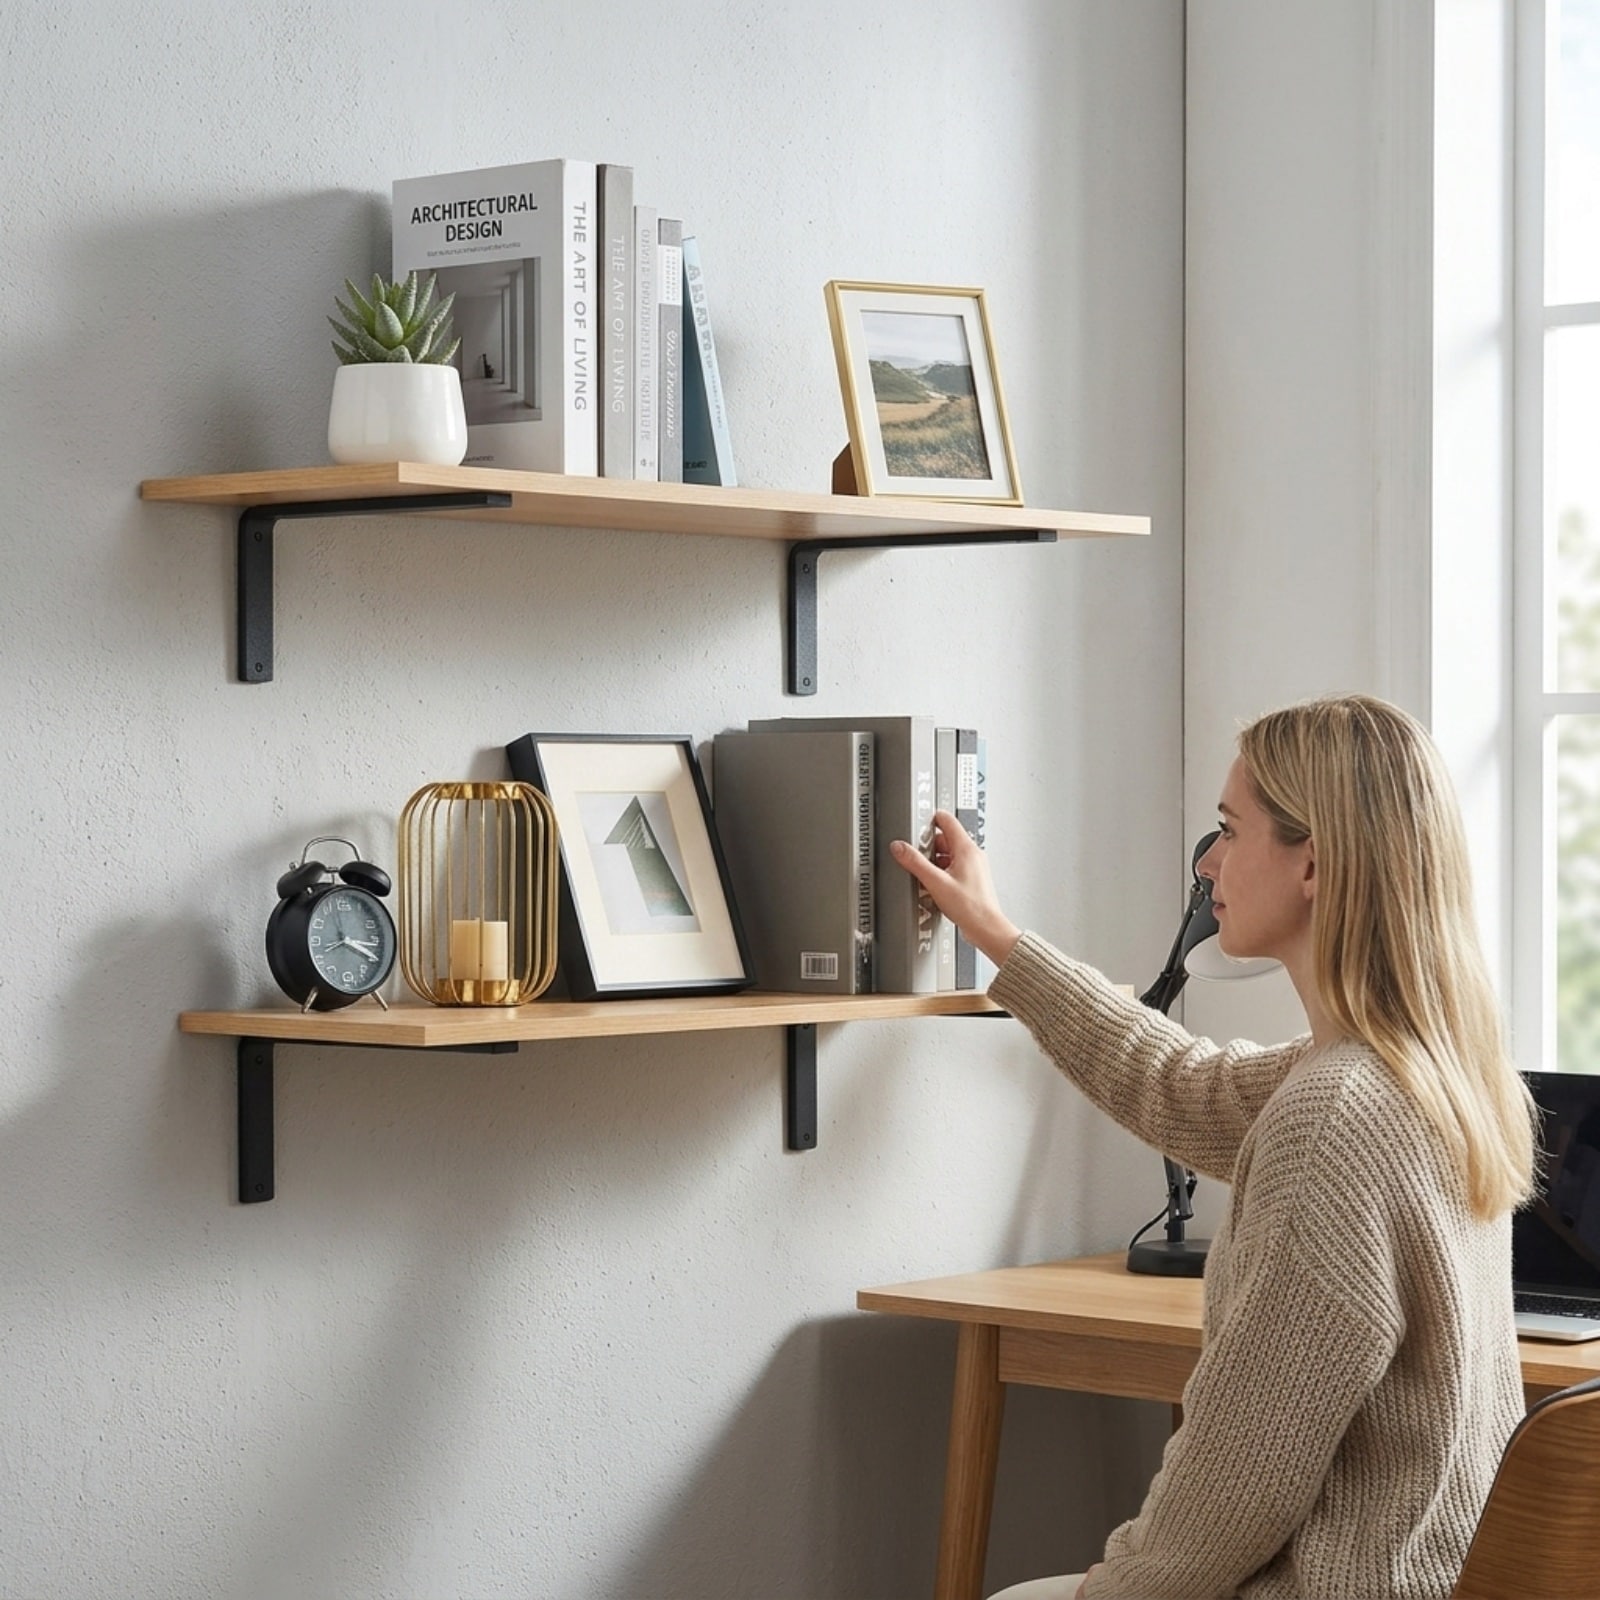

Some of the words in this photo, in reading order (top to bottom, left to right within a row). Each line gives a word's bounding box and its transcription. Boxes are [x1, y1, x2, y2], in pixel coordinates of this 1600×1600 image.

[411, 192, 538, 224] ARCHITECTURAL
[573, 201, 586, 243] THE
[445, 220, 502, 242] DESIGN
[573, 250, 586, 293] ART
[574, 301, 586, 329] OF
[574, 338, 587, 411] LIVING
